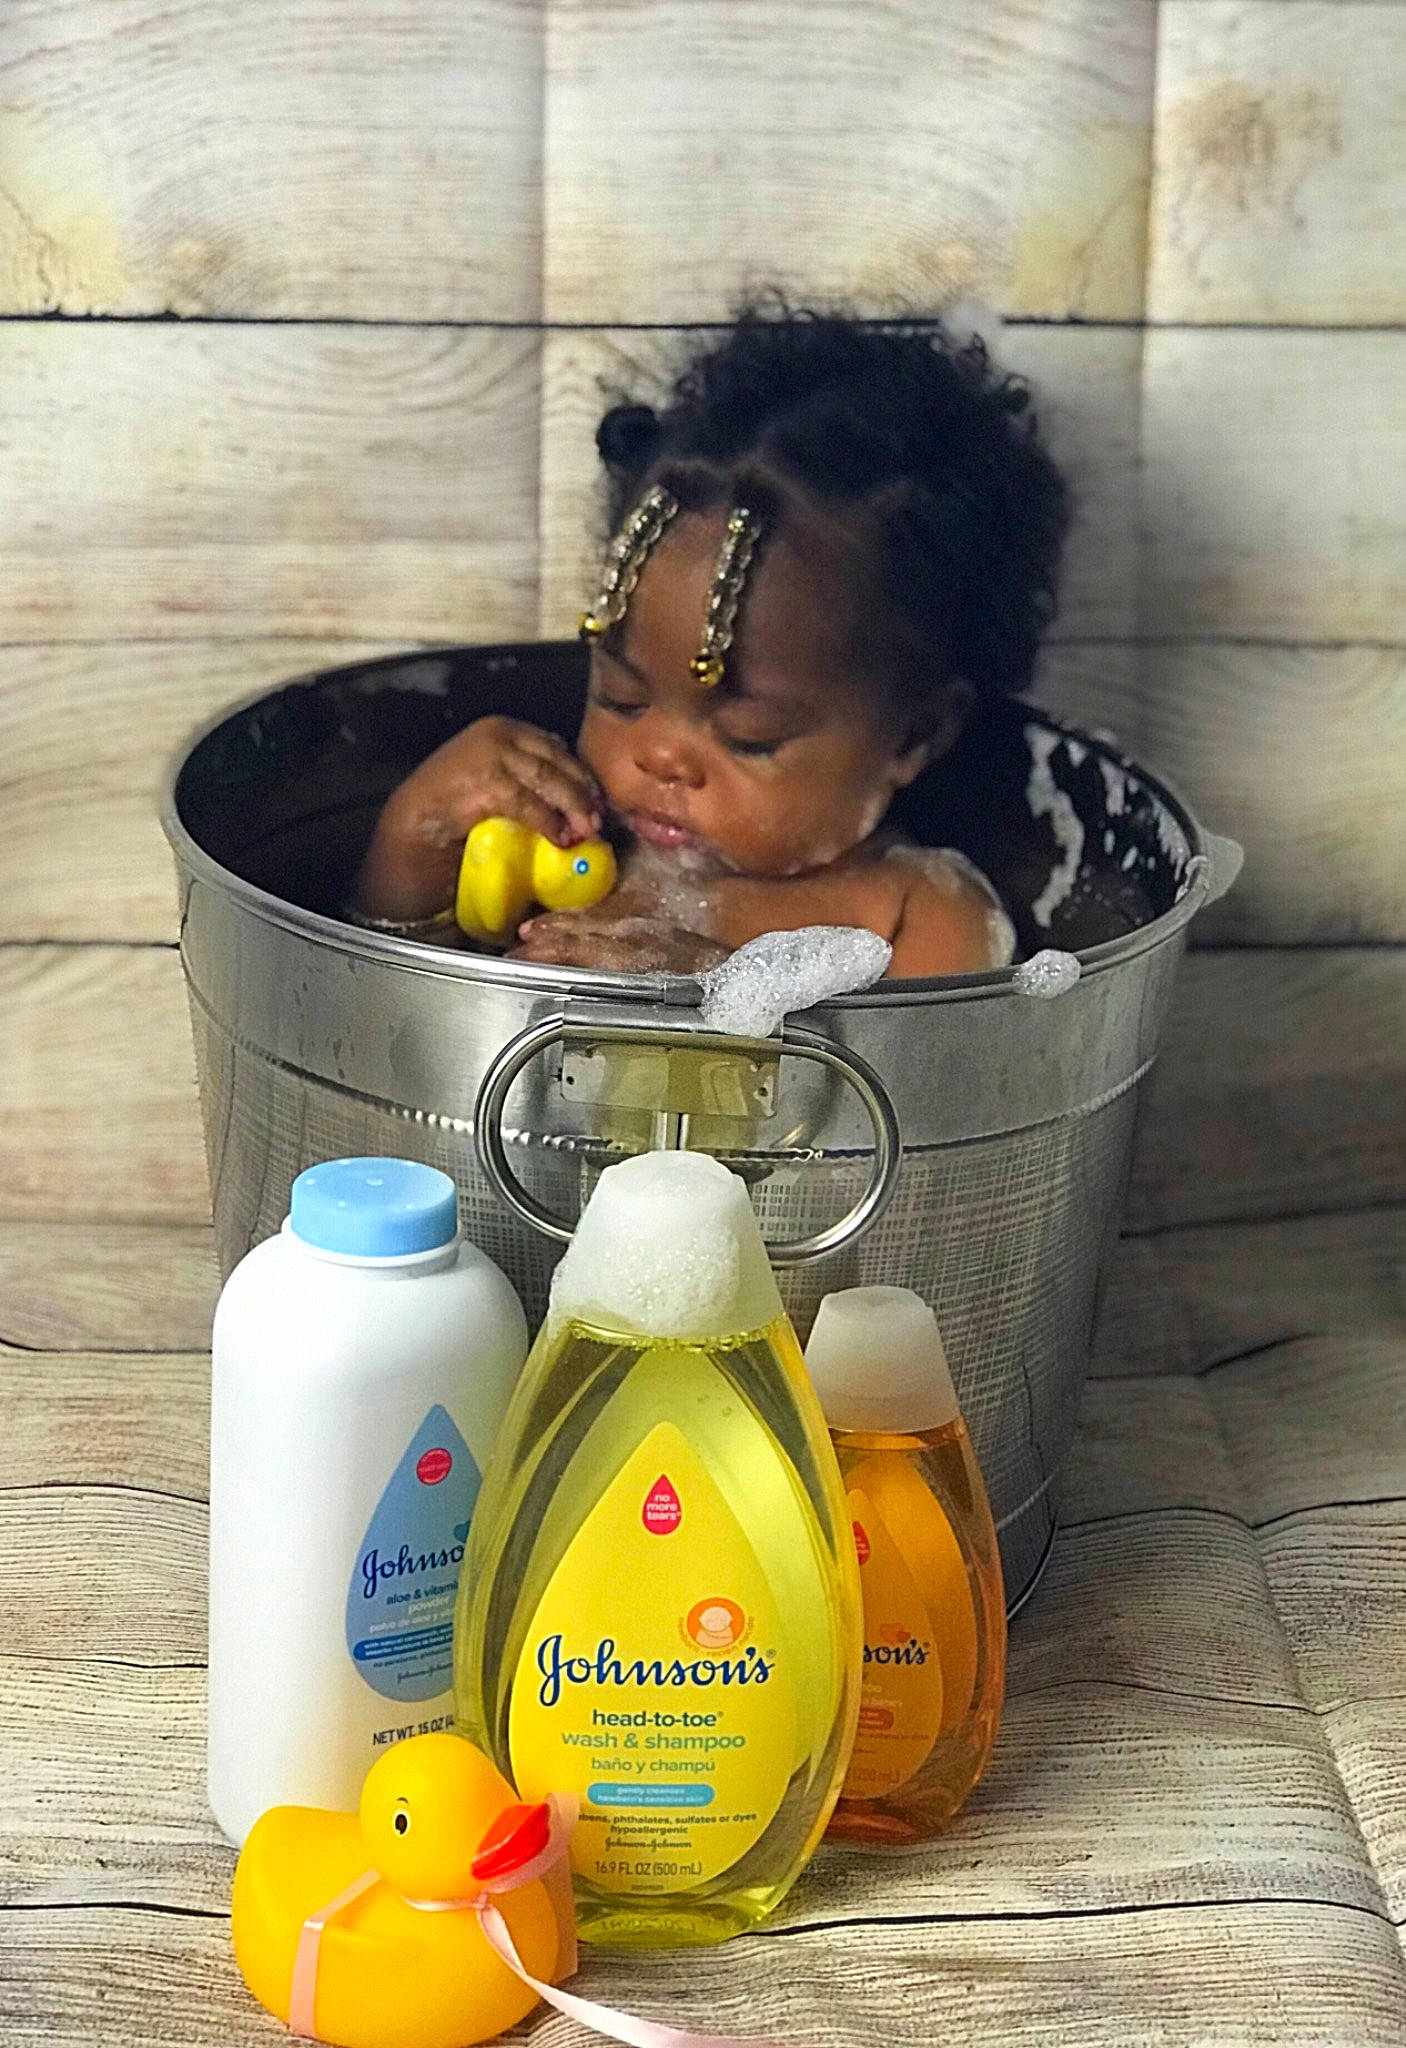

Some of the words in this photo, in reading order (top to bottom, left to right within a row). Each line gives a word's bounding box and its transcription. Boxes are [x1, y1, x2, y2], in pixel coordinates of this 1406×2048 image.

[647, 1503, 677, 1511] more
[387, 1593, 411, 1605] aloe
[413, 1589, 421, 1599] &
[408, 1596, 450, 1615] powder
[538, 1634, 775, 1706] Johnson's
[593, 1709, 717, 1727] head-to-toe
[373, 1729, 395, 1746] NET
[418, 1722, 429, 1736] 15
[431, 1717, 444, 1732] OZ
[562, 1732, 618, 1748] wash
[623, 1732, 639, 1748] &
[644, 1734, 746, 1752] shampoo
[592, 1756, 632, 1770] baño
[637, 1762, 646, 1773] y
[650, 1757, 716, 1773] champú
[733, 1814, 757, 1822] dyes
[610, 1825, 688, 1835] hypoallergenic
[595, 1861, 616, 1874] 16.9
[618, 1862, 633, 1875] FL
[635, 1863, 651, 1875] OZ
[653, 1862, 678, 1876] (500
[680, 1861, 702, 1875] mL)
